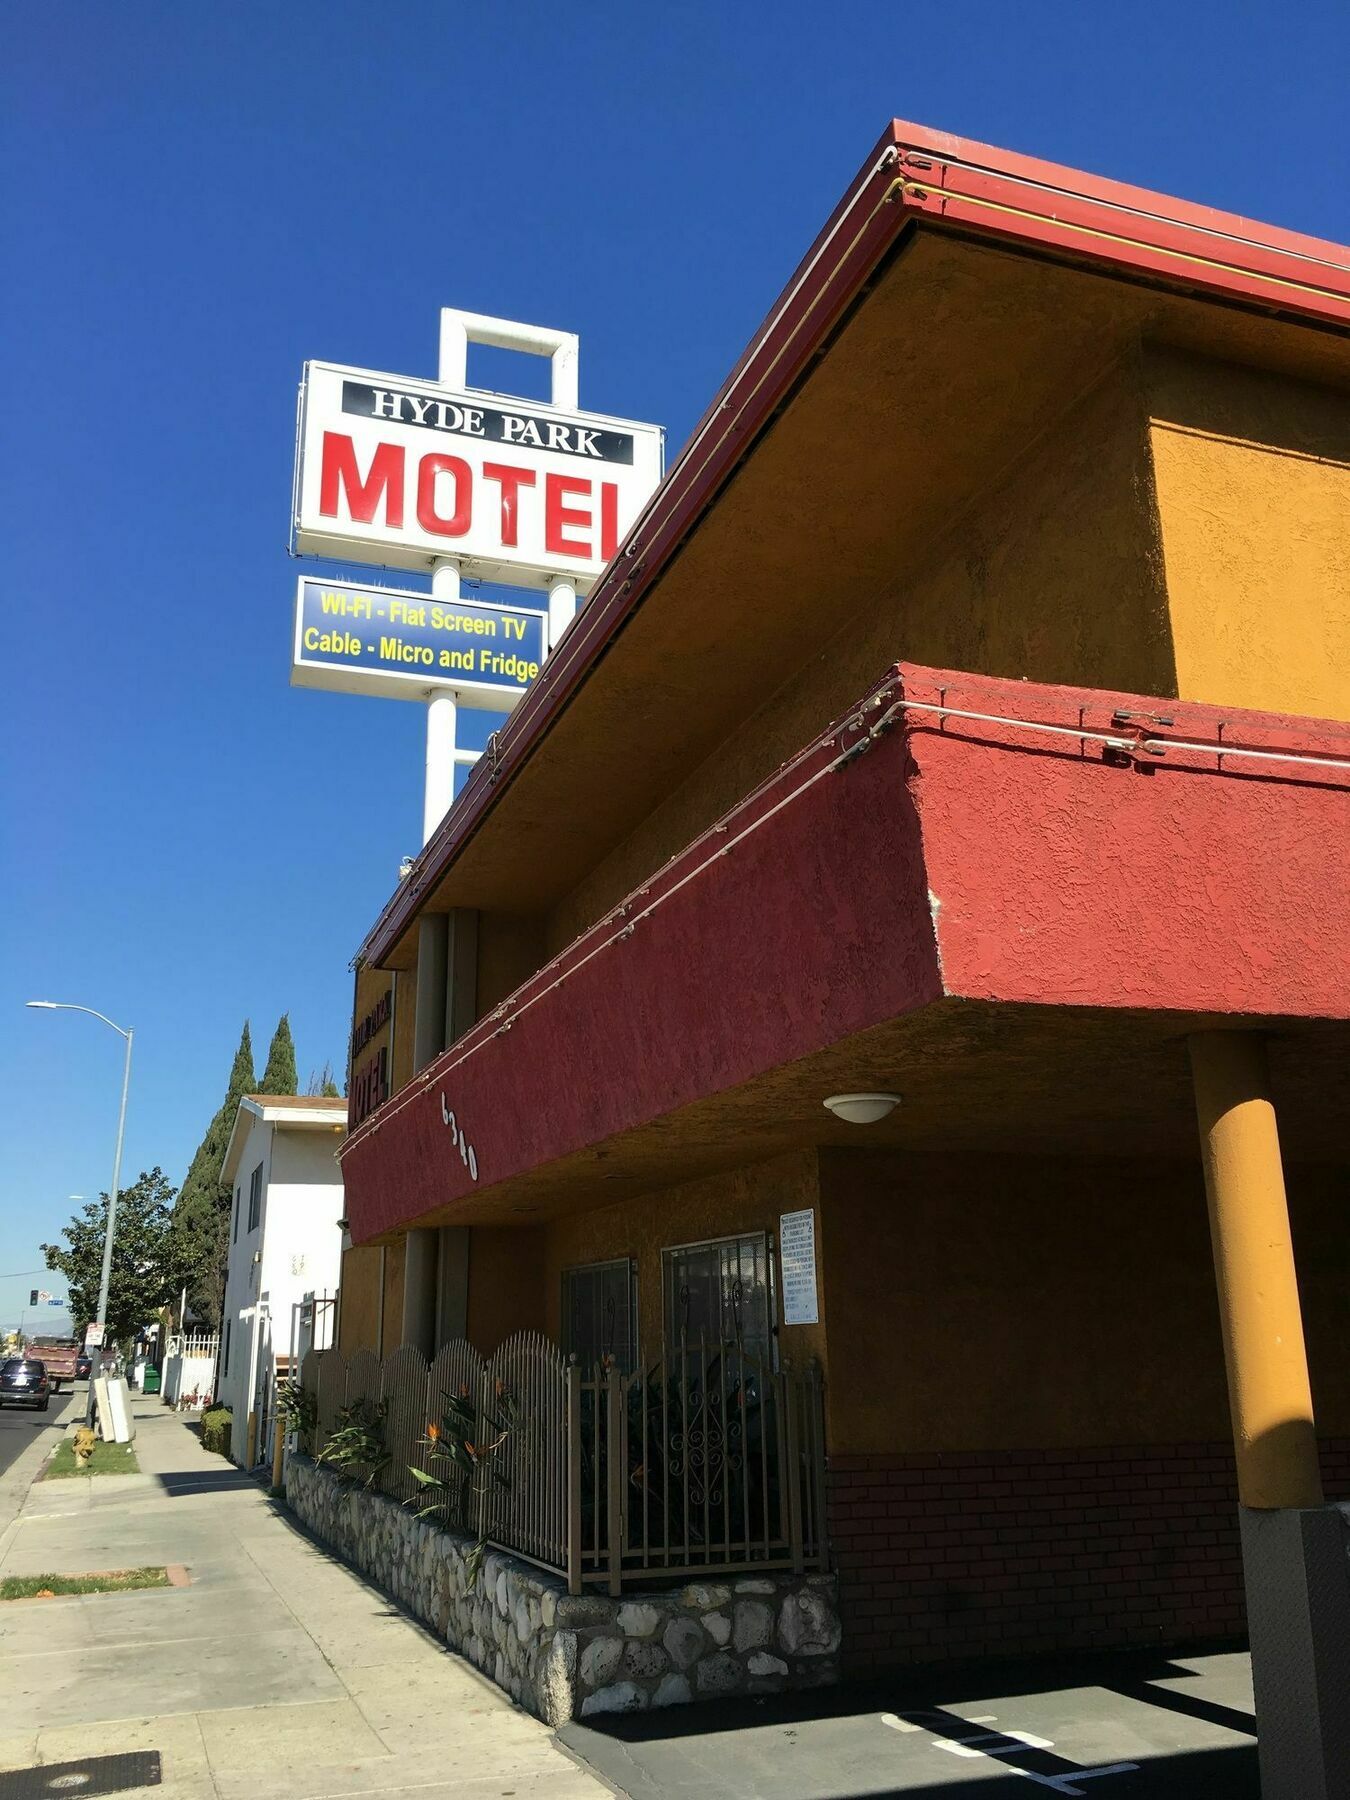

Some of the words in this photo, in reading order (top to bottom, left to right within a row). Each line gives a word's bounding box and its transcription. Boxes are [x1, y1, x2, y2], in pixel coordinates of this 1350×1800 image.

[371, 389, 486, 437] HYDE
[500, 414, 604, 458] PARK
[390, 601, 426, 627] Flat
[430, 607, 496, 636] Screen
[501, 616, 527, 641] TV
[304, 626, 361, 656] Cable
[380, 636, 434, 665] Micro
[439, 648, 474, 671] and
[480, 650, 539, 684] Fridge
